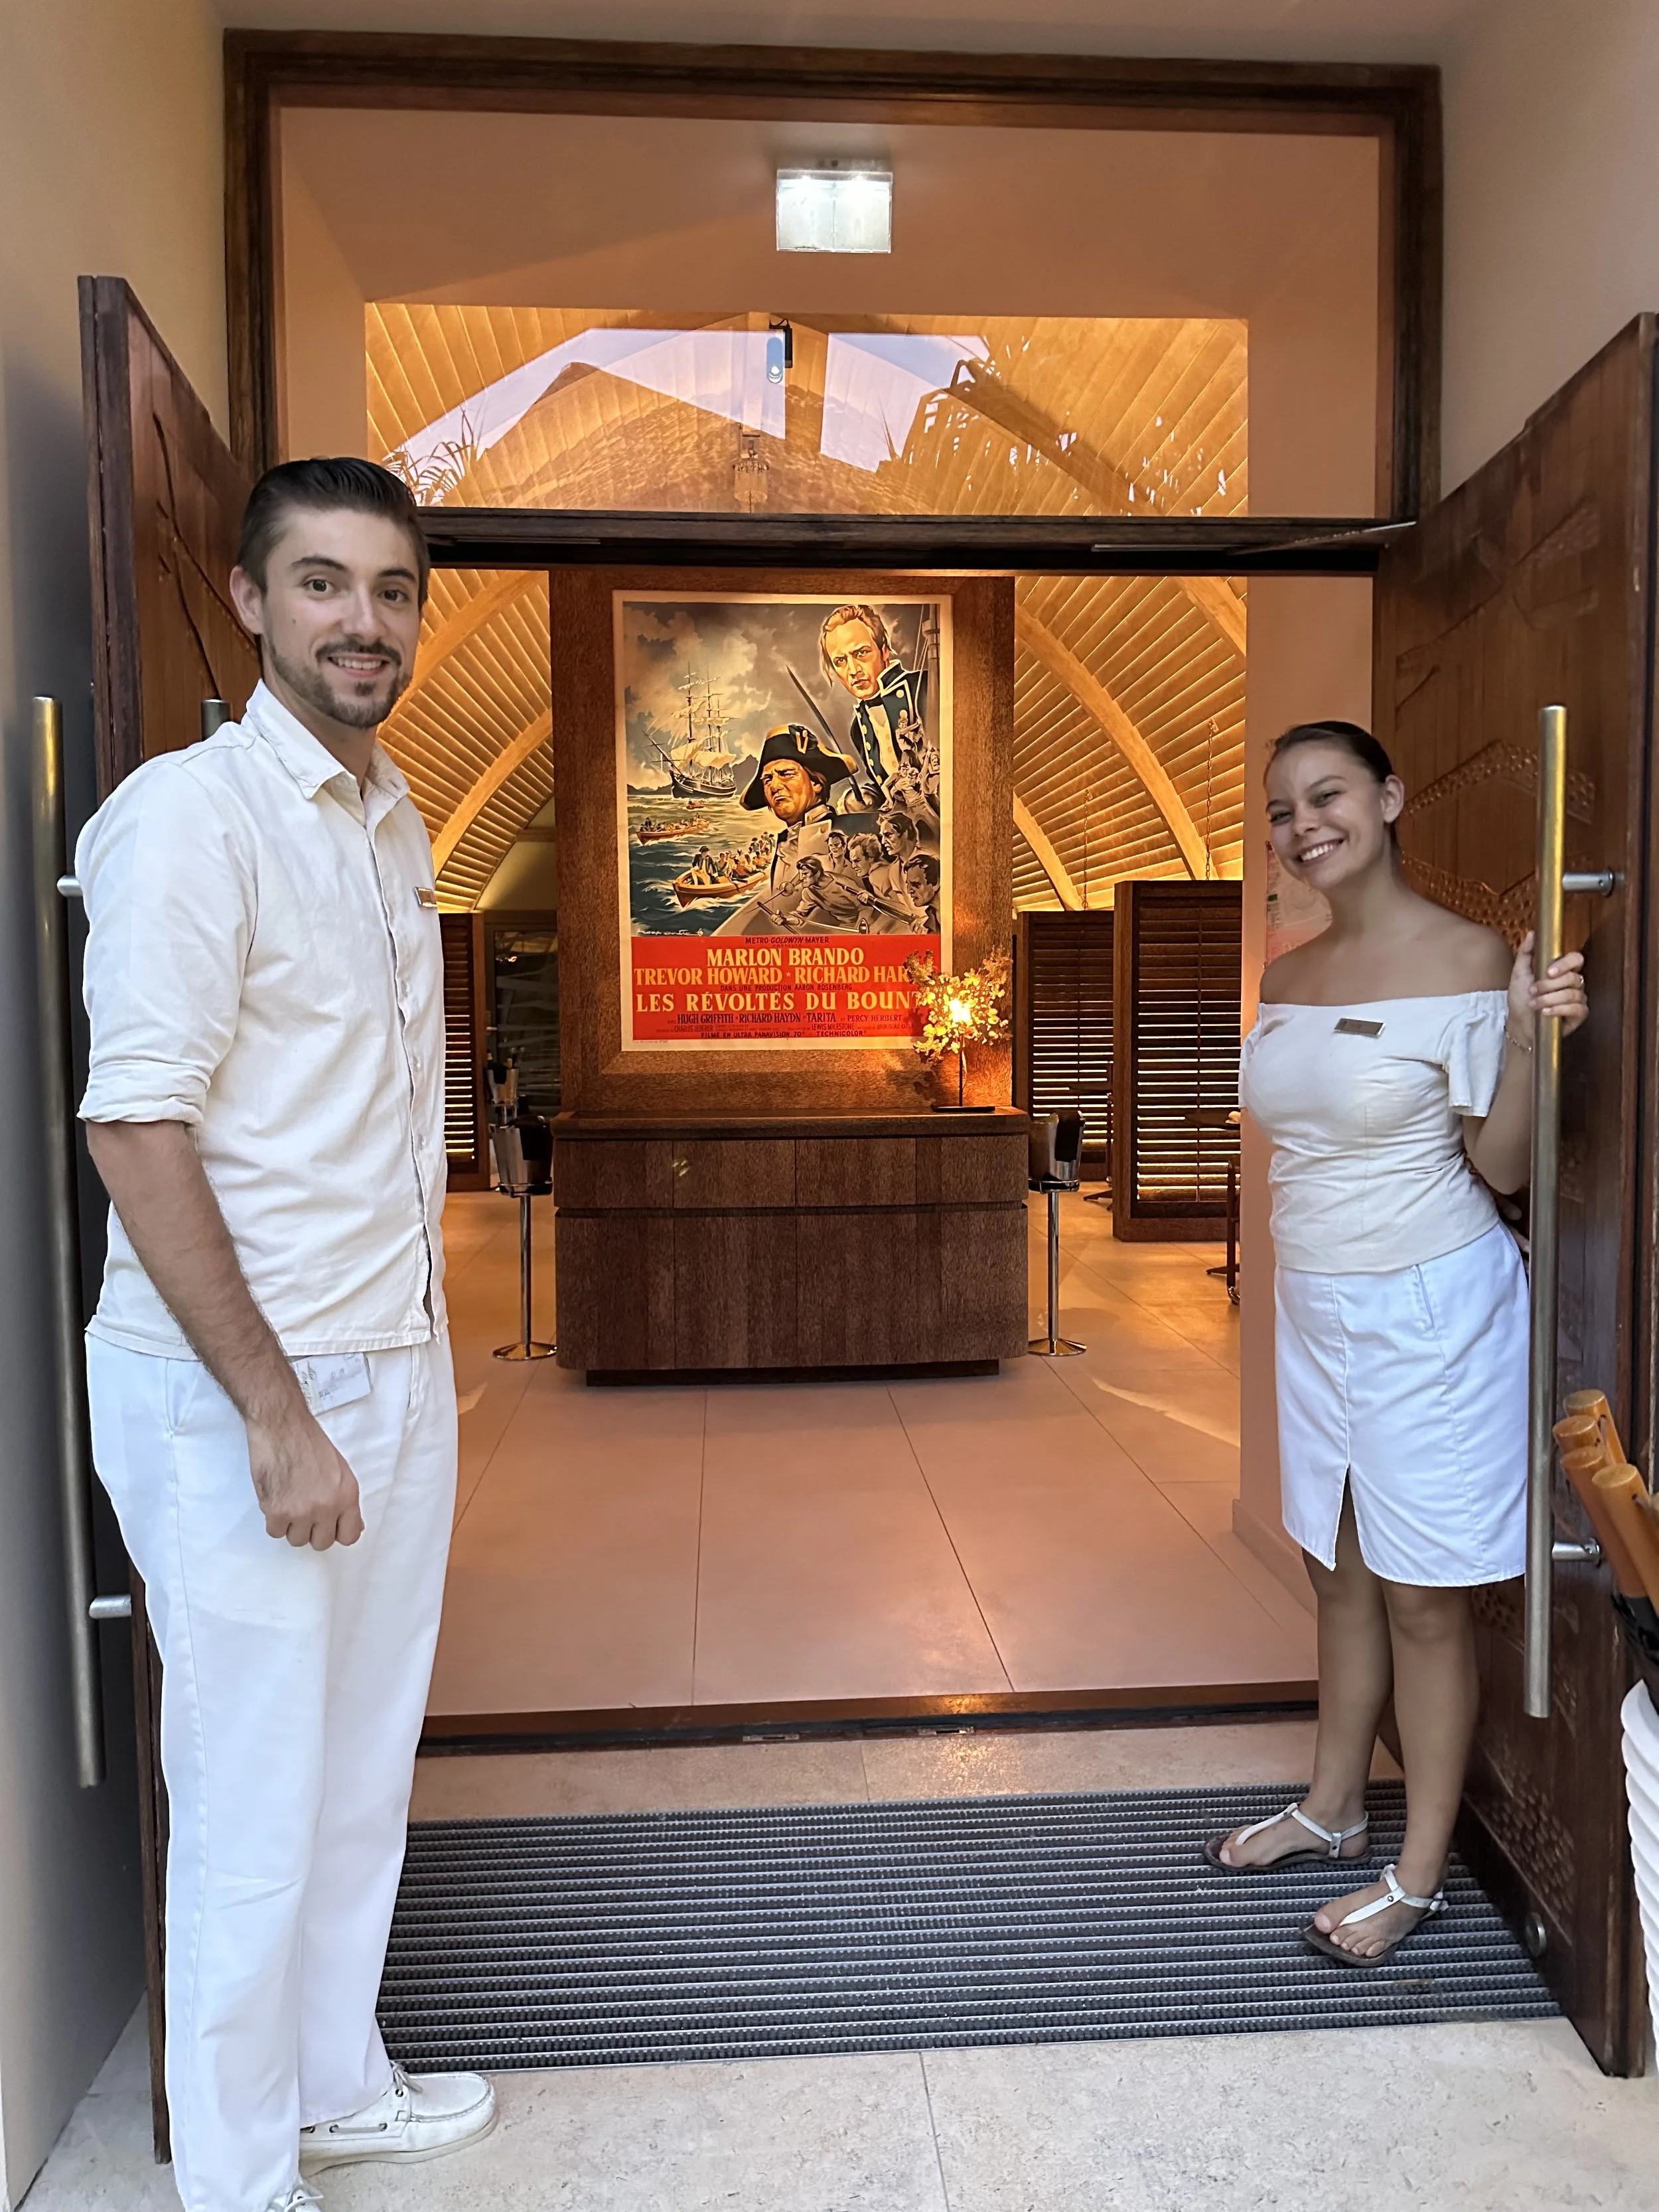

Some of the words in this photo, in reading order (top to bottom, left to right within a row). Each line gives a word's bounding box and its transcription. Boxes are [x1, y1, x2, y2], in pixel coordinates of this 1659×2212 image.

[706, 948, 782, 967] MARLON
[788, 947, 865, 966] BRANDO
[634, 968, 703, 986] TREVOR
[707, 967, 783, 985] HOWARD
[794, 966, 871, 984] RICHARD
[873, 966, 913, 983] HAR
[636, 993, 675, 1012] LES
[685, 991, 794, 1011] RÉVOLTÉS
[805, 992, 837, 1011] DU
[847, 991, 922, 1010] BOUNT
[677, 1013, 699, 1024] HUGH
[700, 1013, 734, 1023] GRIFFITH
[739, 1013, 773, 1023] RICHARD
[774, 1013, 802, 1023] HAYDN
[806, 1012, 836, 1023] TARITA
[871, 1013, 902, 1022] HERBERT
